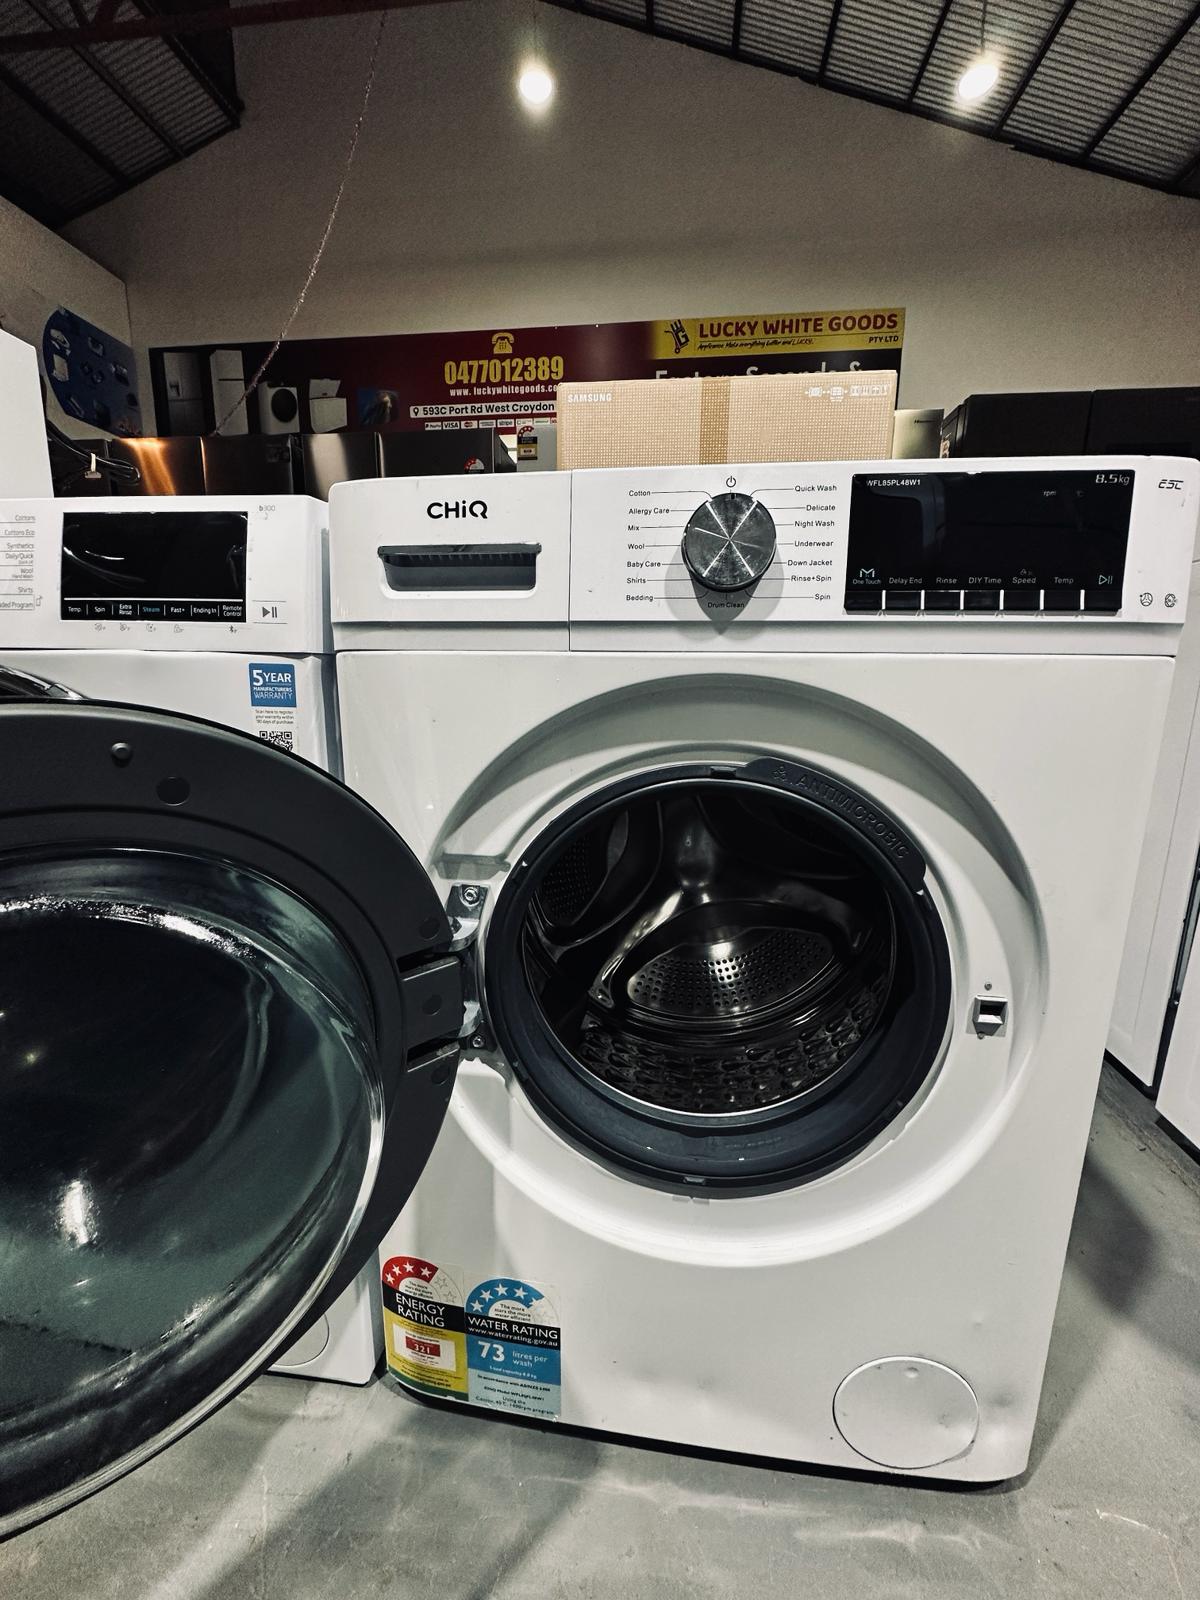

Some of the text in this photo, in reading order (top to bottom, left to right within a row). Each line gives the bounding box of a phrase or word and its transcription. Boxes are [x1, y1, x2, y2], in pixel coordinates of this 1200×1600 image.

[699, 313, 898, 339] LUCKY WHITE GOODS
[868, 335, 899, 344] PTY LTD
[444, 355, 564, 385] 0477012389
[474, 383, 557, 396] luckywhitegoods.co
[567, 392, 612, 403] SAMSUNG
[422, 401, 555, 416] 593C Port Rd West Croydon
[866, 479, 921, 487] WFL85PL48W1
[795, 484, 838, 493] Quick Wash
[628, 489, 651, 498] Cotton
[628, 507, 670, 516] Allergy Care
[806, 504, 836, 512] Delicate
[627, 524, 640, 532] Mix
[794, 519, 836, 529] Night Wash
[794, 540, 834, 548] Underwear
[626, 560, 662, 569] Baby Care
[787, 559, 833, 567] Down Jacket
[626, 577, 647, 585] Shirts
[790, 575, 832, 583] Rinse+Spin
[888, 577, 923, 586] Delay End
[935, 577, 957, 585] Rinse
[1012, 577, 1037, 585] Speed
[1053, 577, 1074, 585] Temp
[625, 594, 654, 602] Bedding
[814, 593, 832, 602] Spin
[725, 601, 745, 609] Clean
[252, 669, 292, 687] 5 YEAR
[253, 691, 293, 700] WARRANTY
[395, 1292, 446, 1317] ENERGY
[397, 1304, 446, 1328] RATING
[467, 1315, 510, 1332] WATER
[511, 1324, 559, 1340] RATING
[467, 1326, 558, 1347] www.waterrating.gov.au
[477, 1340, 506, 1362] 73
[512, 1350, 549, 1364] litres per
[512, 1359, 533, 1368] wash
